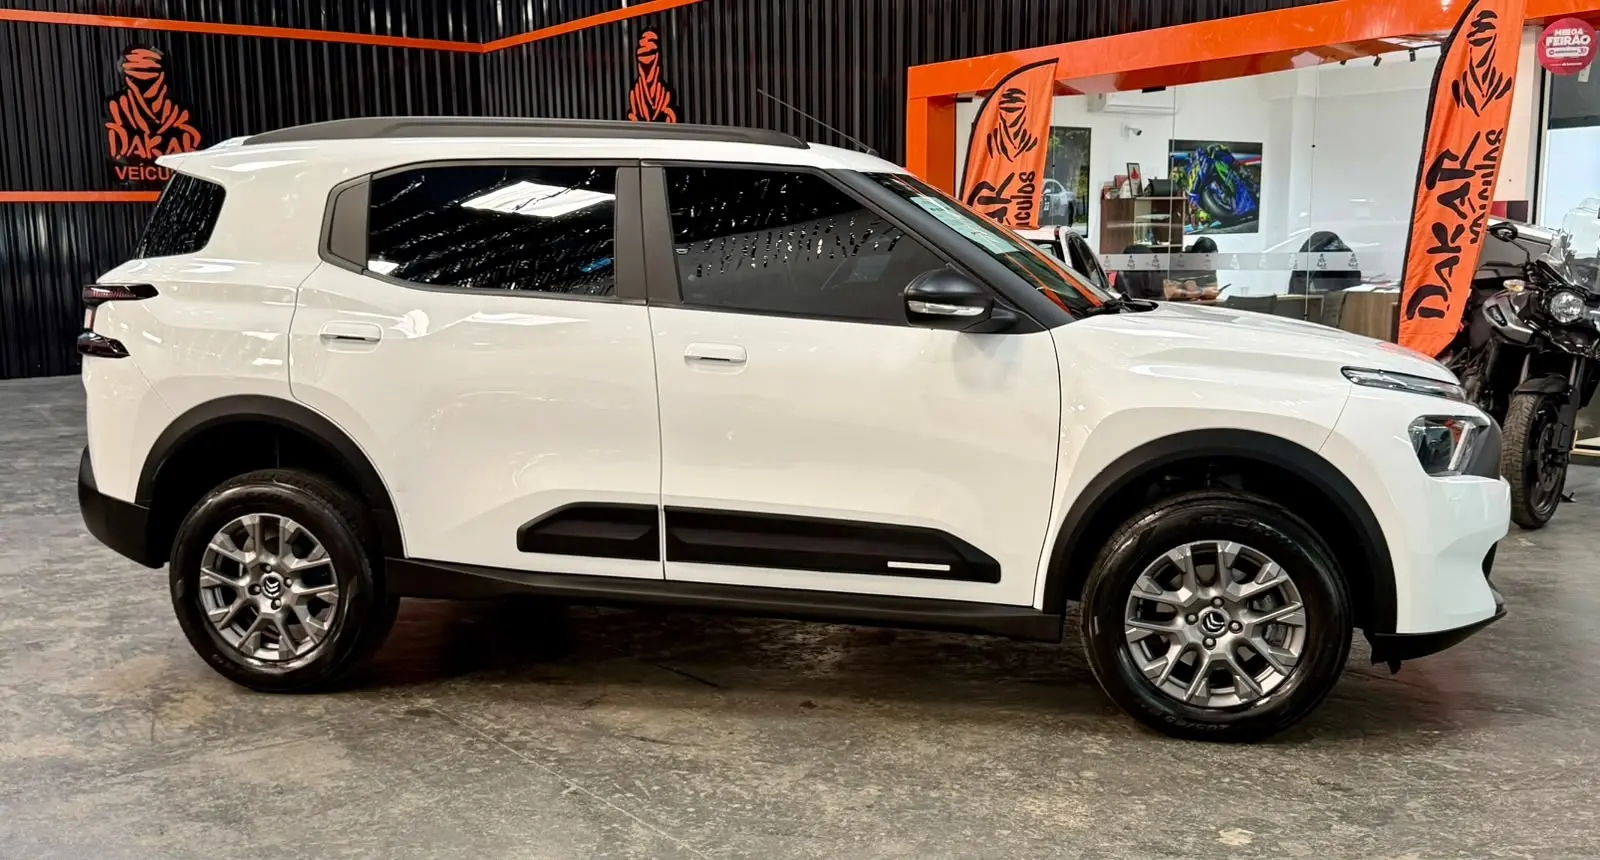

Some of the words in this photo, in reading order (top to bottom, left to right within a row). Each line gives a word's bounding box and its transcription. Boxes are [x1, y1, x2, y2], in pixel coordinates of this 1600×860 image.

[1554, 28, 1584, 36] MEGA
[105, 121, 201, 160] DAKAR
[114, 162, 170, 181] VEÍCU
[1406, 131, 1480, 321] DAKAR
